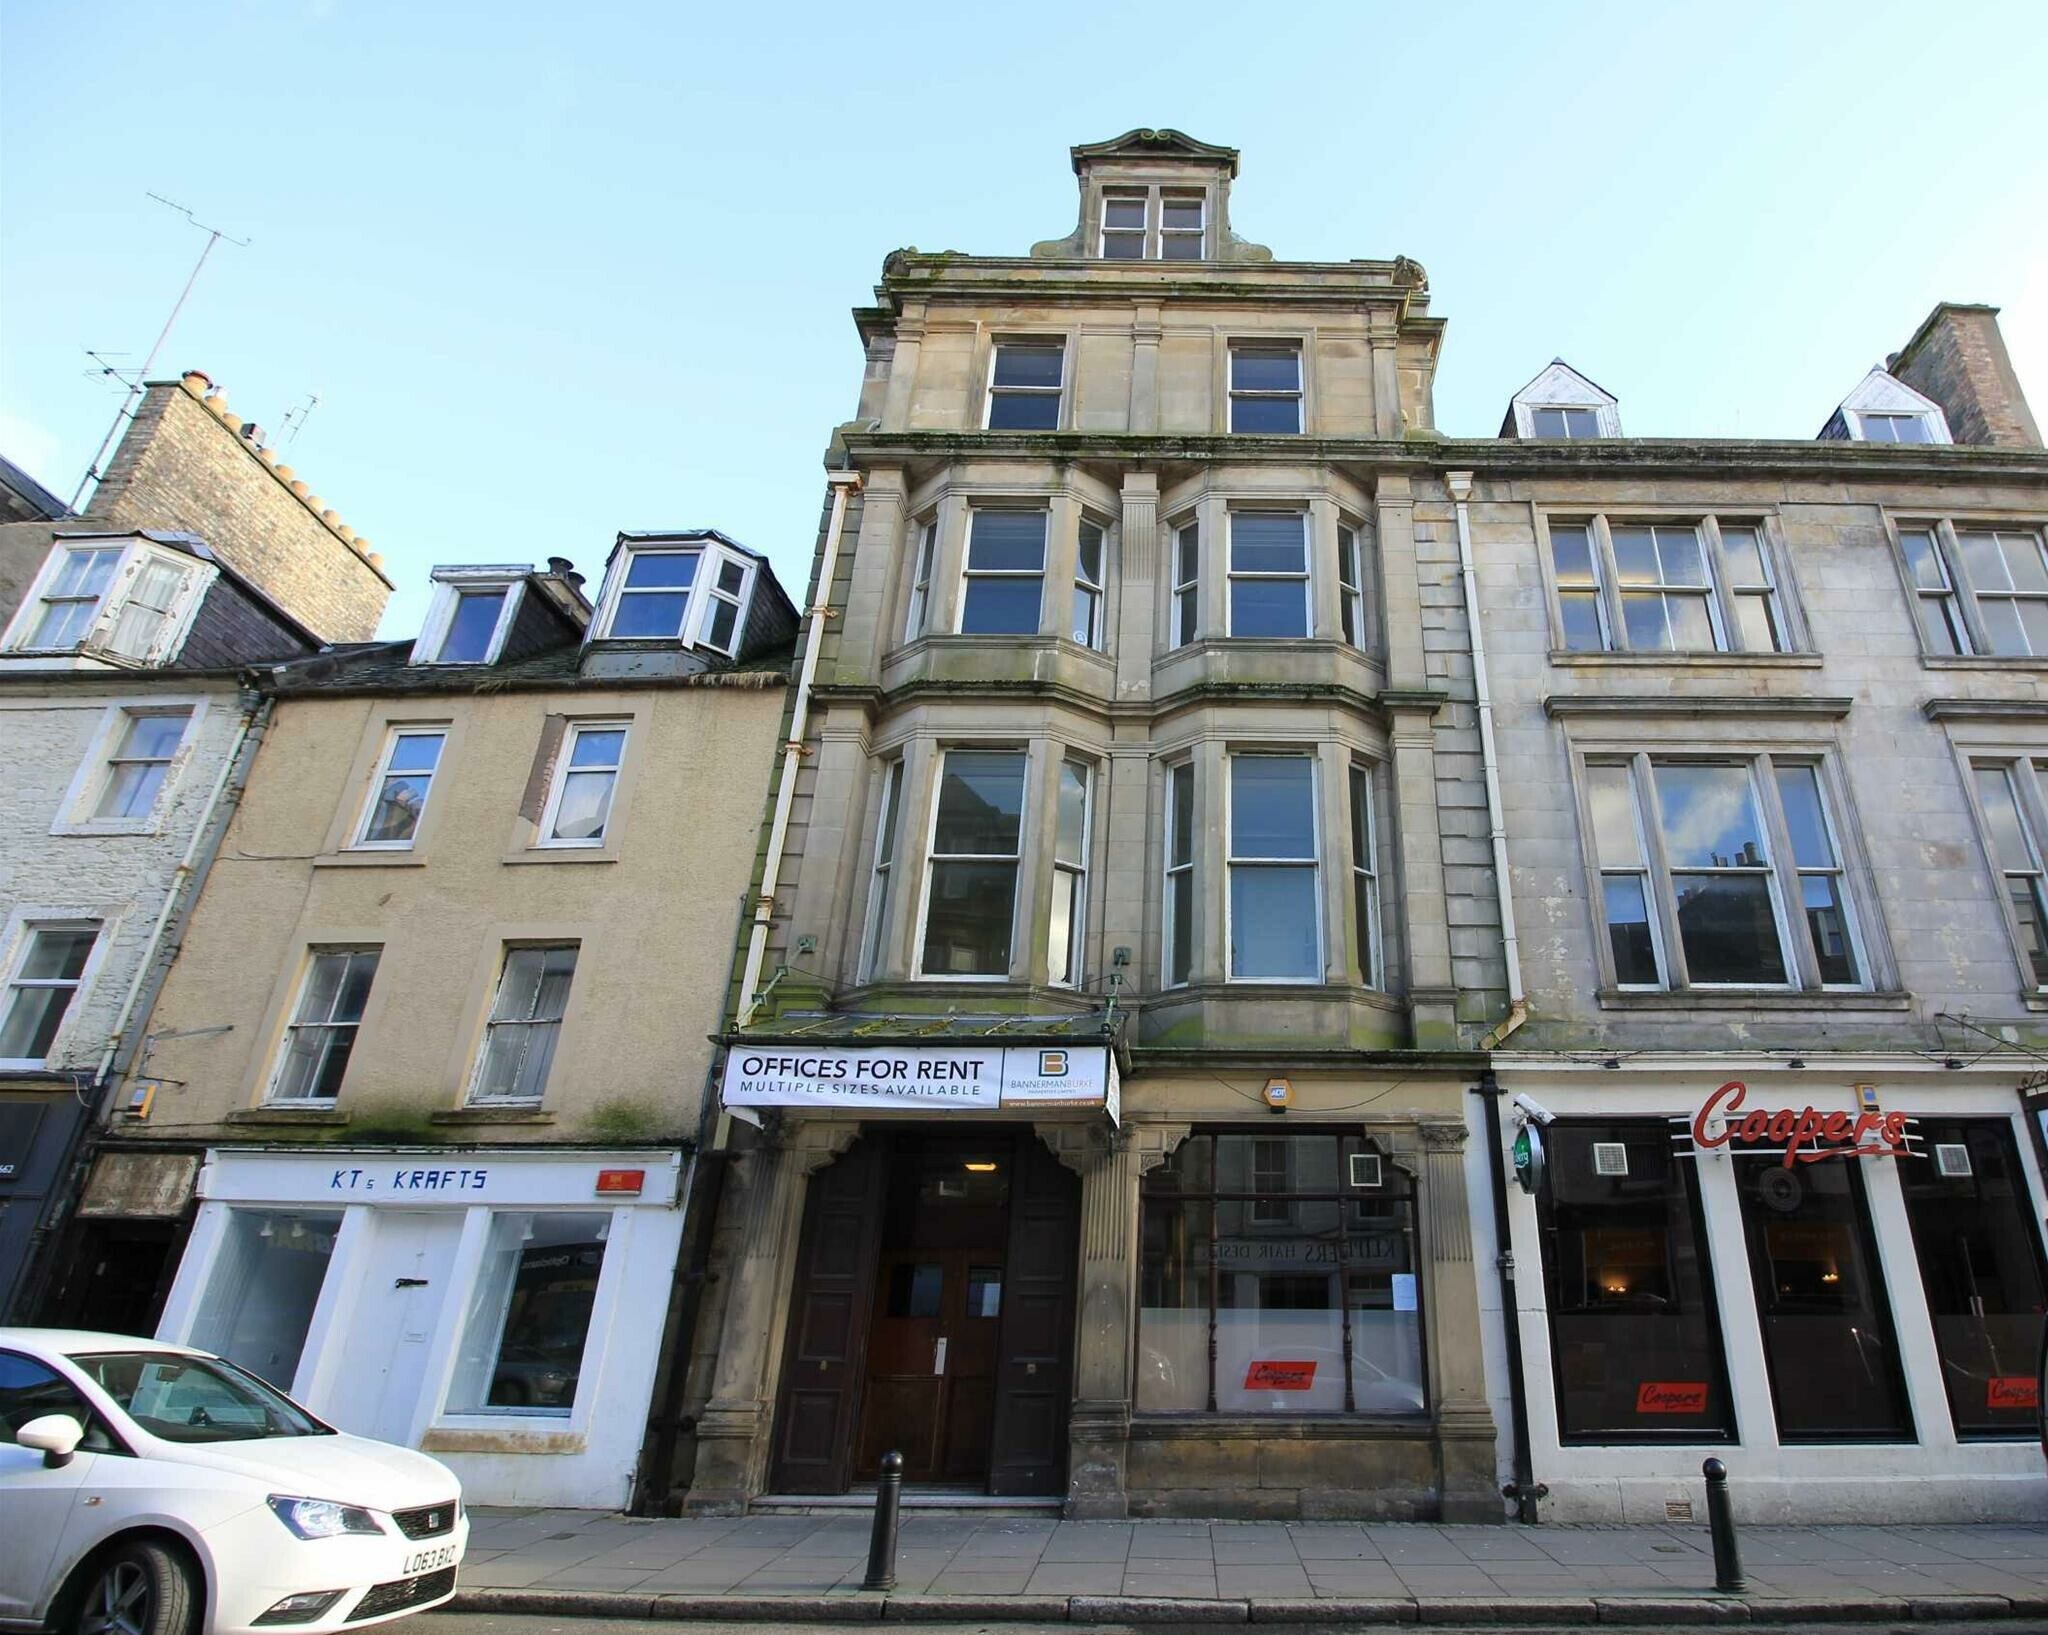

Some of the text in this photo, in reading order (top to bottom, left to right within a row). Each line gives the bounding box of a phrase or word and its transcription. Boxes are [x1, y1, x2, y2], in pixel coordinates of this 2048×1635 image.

[742, 1057, 984, 1080] OFFICES FOR RENT
[740, 1081, 981, 1095] MULTIPLE SIZES AVAILABLE
[1011, 1079, 1093, 1088] BANNERMANBURKE
[1694, 1081, 1908, 1168] Coopers
[394, 1170, 487, 1189] KRAFTS
